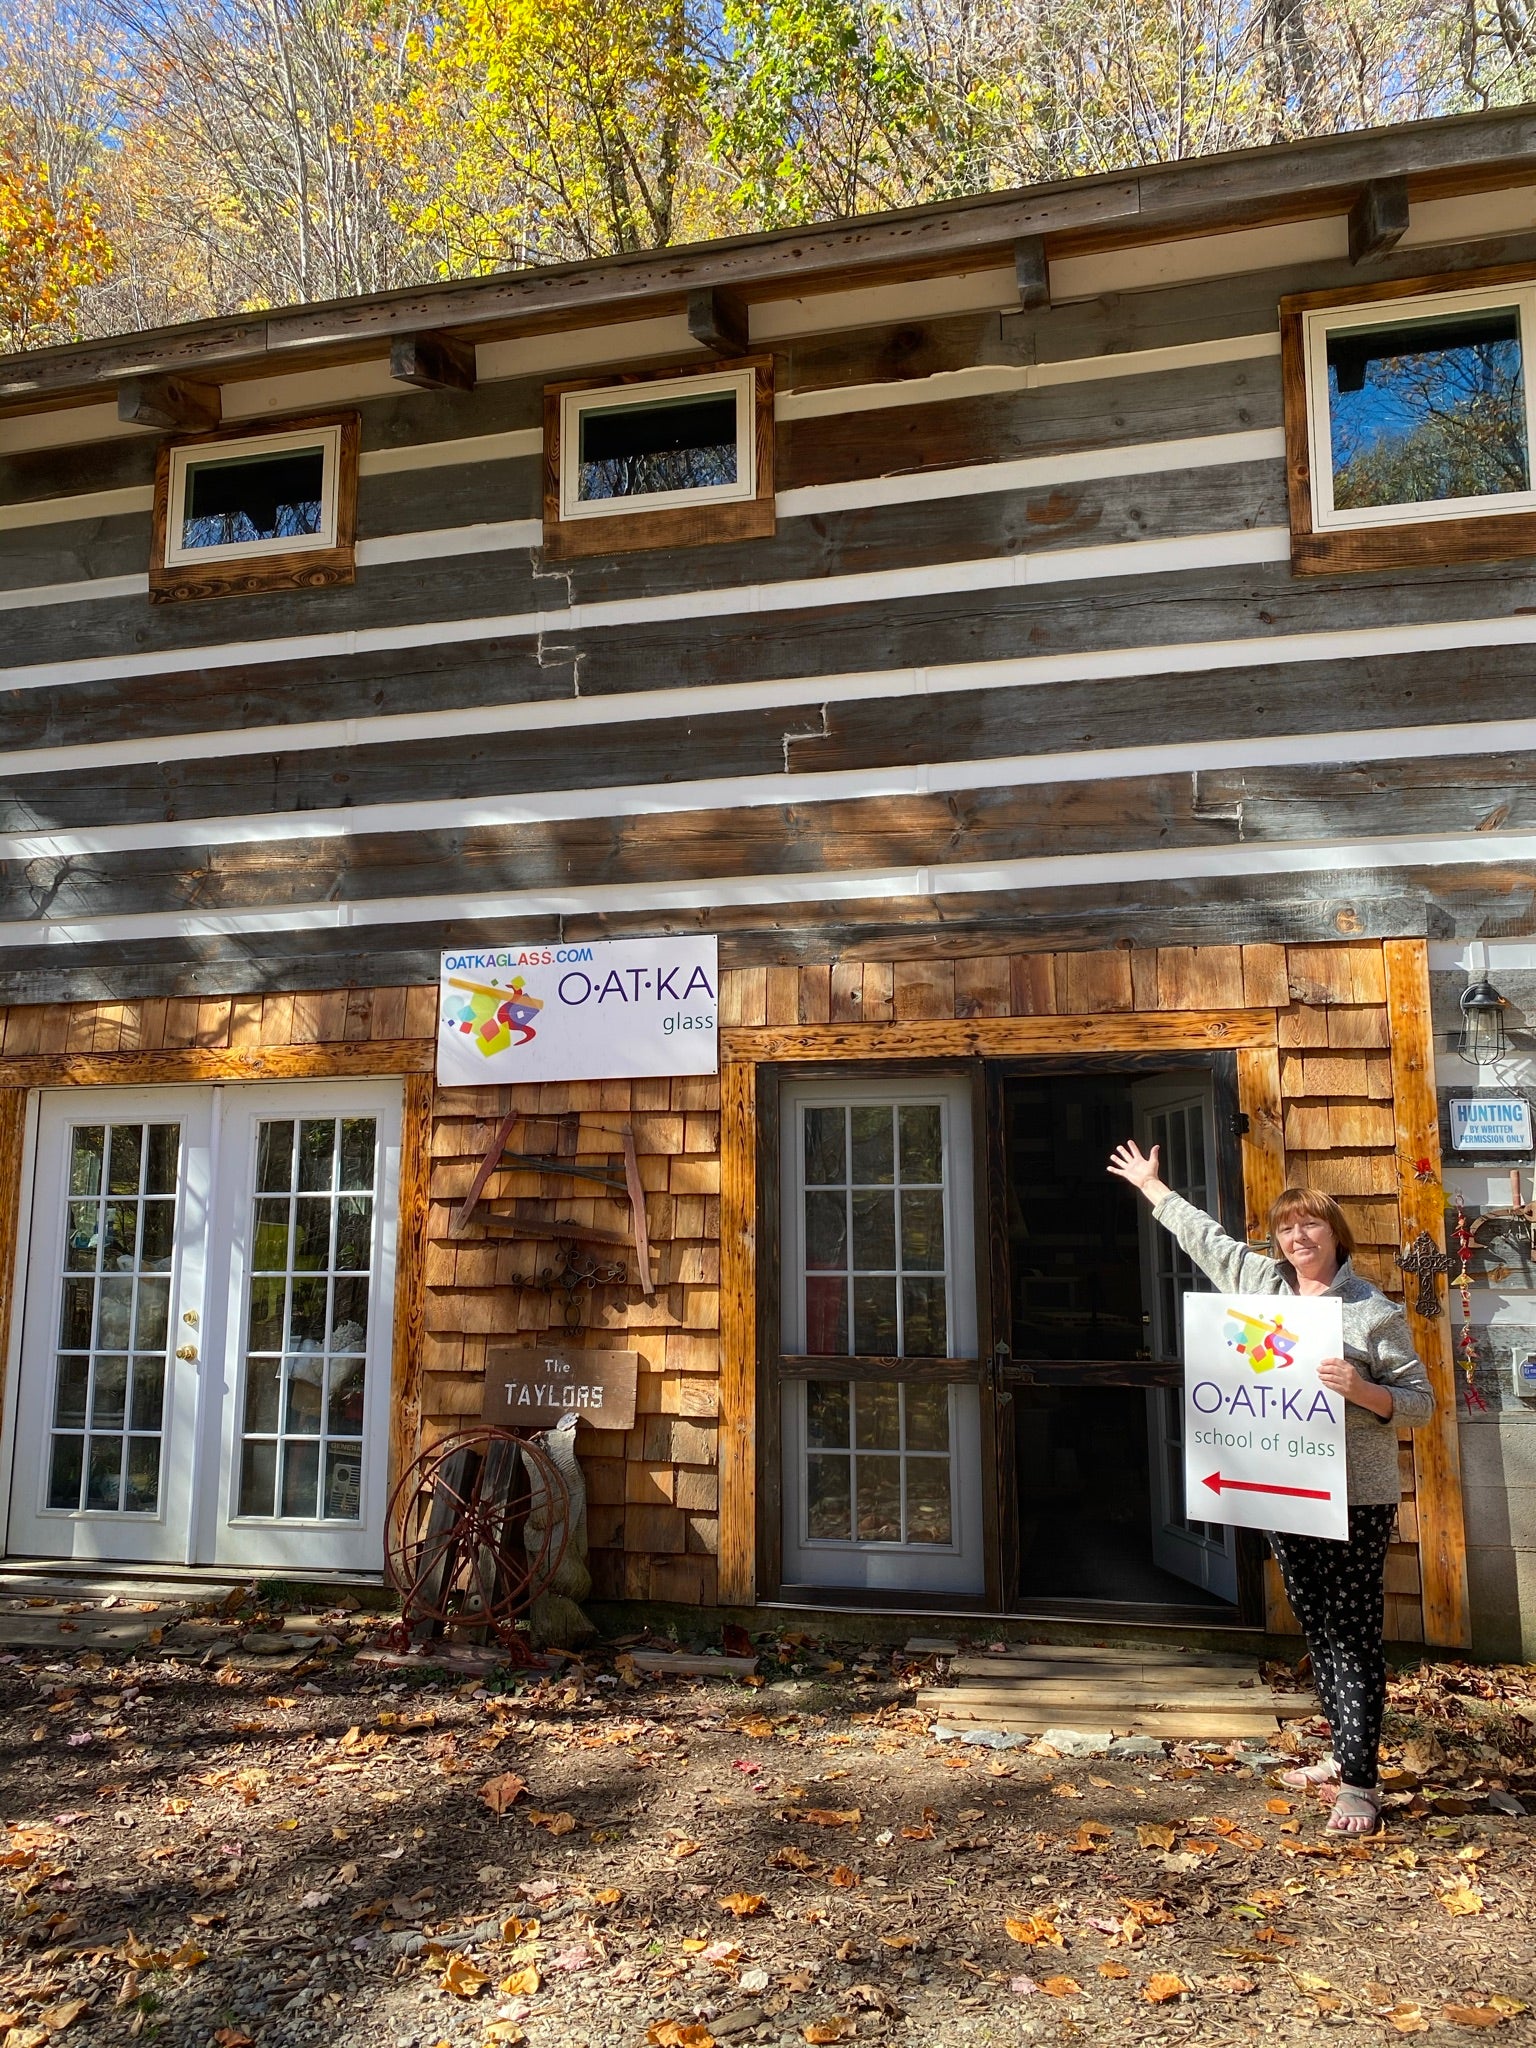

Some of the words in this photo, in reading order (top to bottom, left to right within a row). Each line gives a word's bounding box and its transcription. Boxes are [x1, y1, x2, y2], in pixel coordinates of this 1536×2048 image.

[445, 948, 593, 970] OATKAGLASS.COM
[663, 1012, 714, 1035] glass
[1457, 1105, 1523, 1121] HUNTING
[1470, 1125, 1479, 1133] BY
[1481, 1125, 1513, 1133] WRITTEN
[1460, 1135, 1504, 1143] PERMISSION
[1506, 1135, 1525, 1143] ONLY
[544, 1359, 571, 1373] The
[504, 1383, 604, 1408] TAYLORS
[1194, 1428, 1252, 1449] school
[1261, 1433, 1280, 1451] of
[1288, 1436, 1335, 1457] glass
